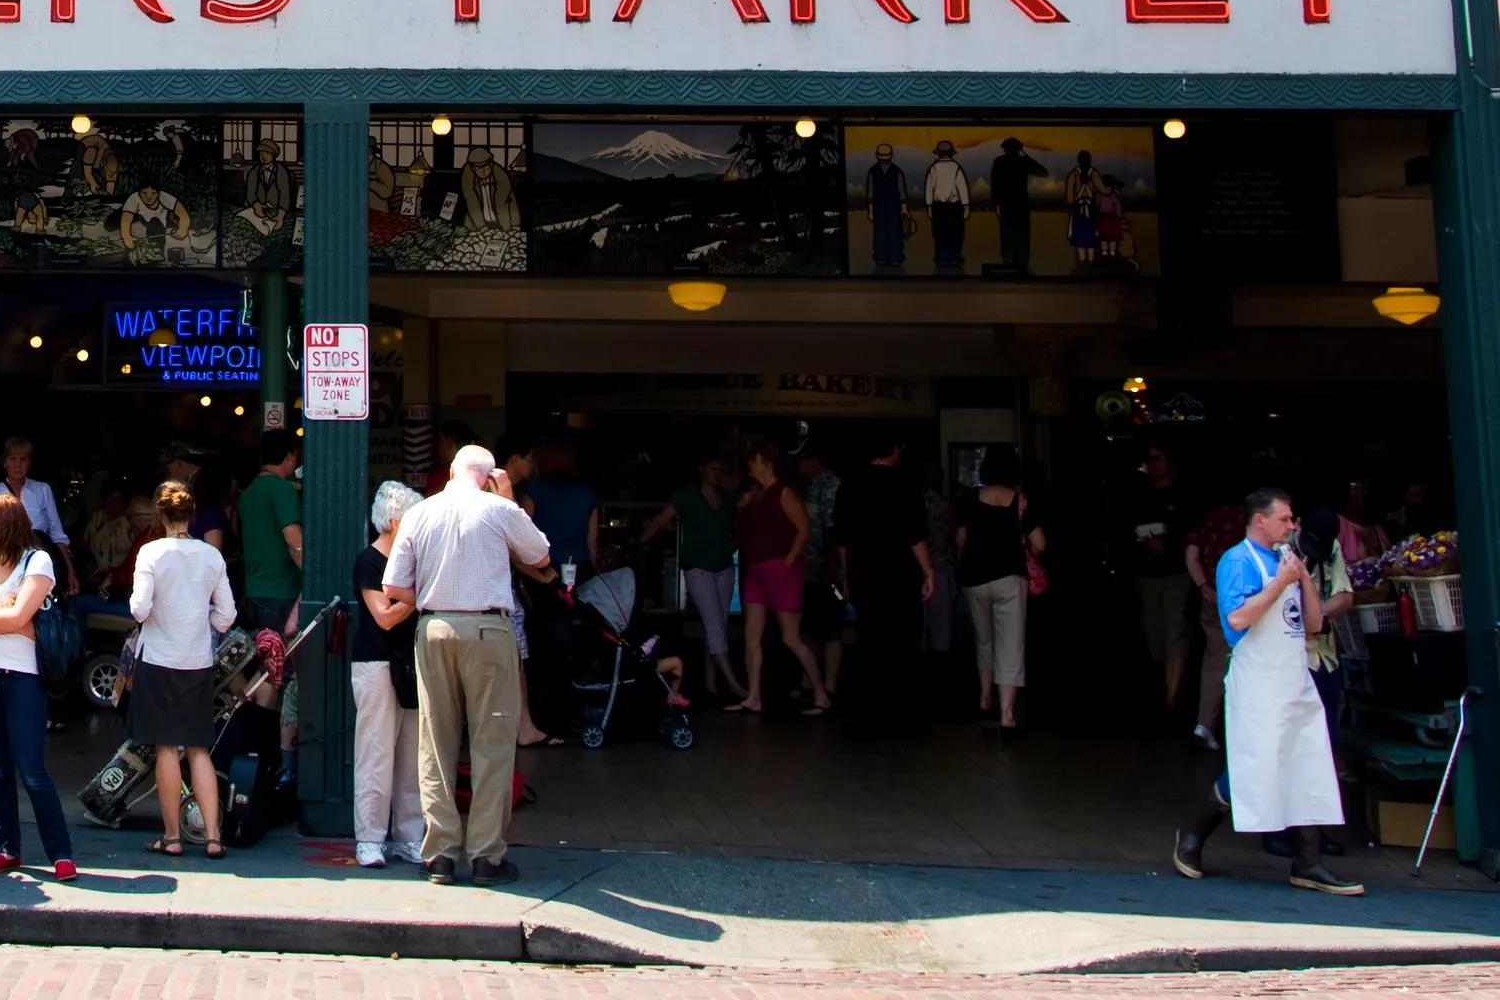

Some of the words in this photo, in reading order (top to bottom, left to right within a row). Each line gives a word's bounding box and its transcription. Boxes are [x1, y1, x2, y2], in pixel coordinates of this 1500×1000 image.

[311, 327, 334, 345] NO
[141, 345, 260, 368] VIEWPOI
[312, 351, 360, 367] STOPS
[174, 371, 214, 381] PUBLIC
[217, 371, 258, 381] SEATIN
[311, 376, 361, 387] TOW-AWAY
[322, 390, 350, 400] ZONE
